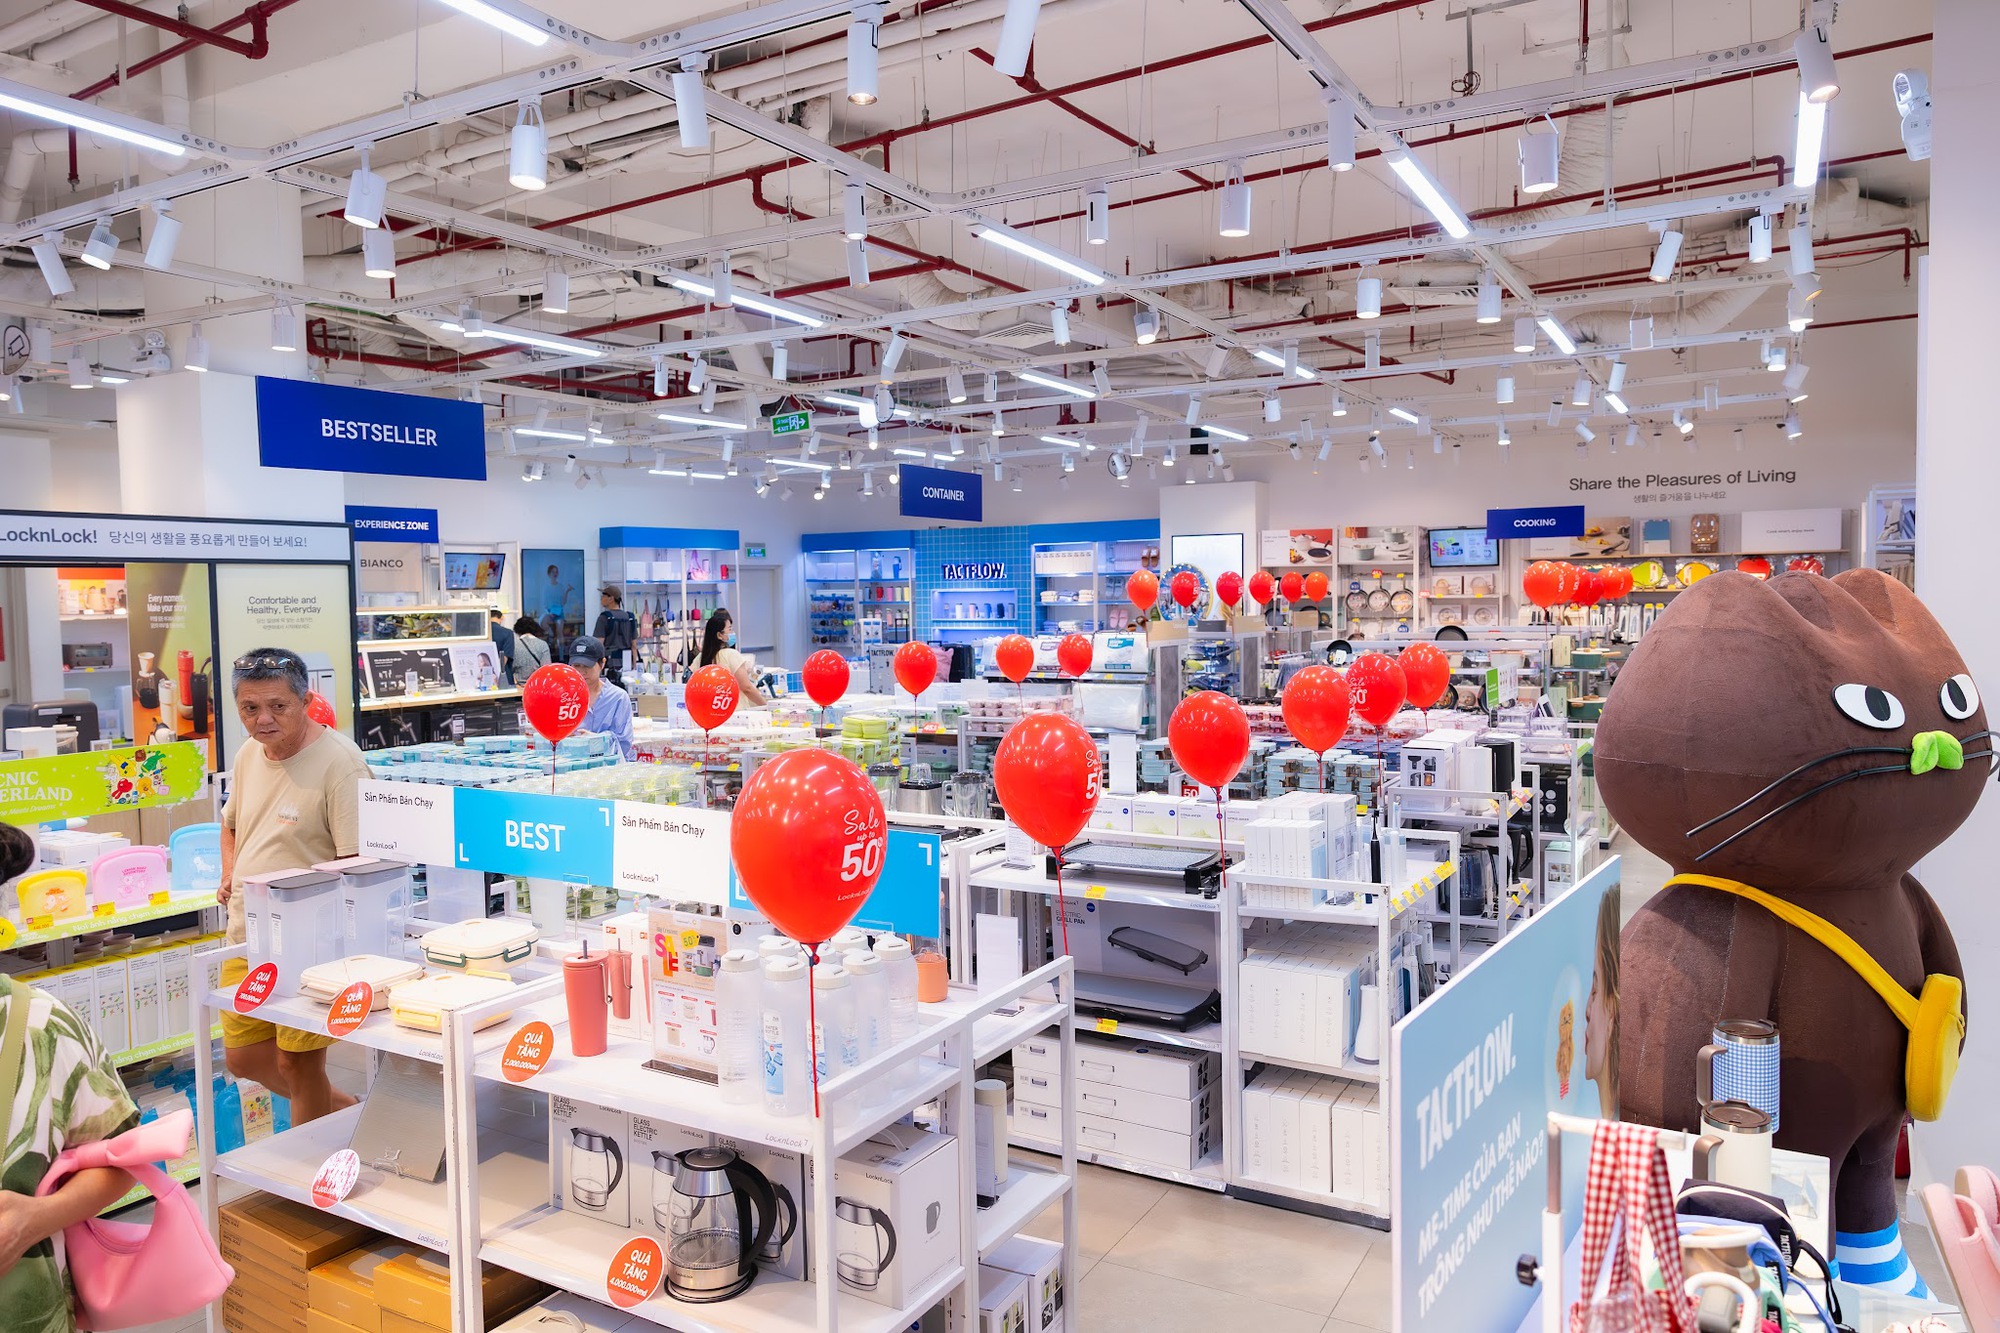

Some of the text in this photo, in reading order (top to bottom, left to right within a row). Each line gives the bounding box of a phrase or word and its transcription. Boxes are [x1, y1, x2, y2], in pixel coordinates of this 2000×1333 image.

[321, 418, 438, 446] BESTSELLER
[1569, 469, 1797, 491] Share the Pleasures of Living
[922, 486, 965, 502] CONTAINER
[355, 519, 430, 531] EXPERIENCE ZONE
[1513, 518, 1557, 528] COOKING
[0, 527, 98, 543] ocknLock!
[109, 531, 308, 548] 당신의 생활을 풍요롭게 만들어 보세요!
[360, 559, 403, 568] BIANCO
[942, 562, 1007, 580] TACTFLOW.
[248, 596, 316, 604] Comfortable and
[147, 604, 161, 612] Make
[162, 604, 173, 613] your
[247, 606, 321, 615] Healthy, Everyday
[560, 692, 580, 703] Sale
[400, 795, 413, 805] Bán
[414, 797, 434, 810] Chạy
[622, 815, 636, 827] Sản
[664, 821, 679, 833] Bán
[682, 823, 705, 838] Chạy
[844, 806, 880, 835] Sale
[505, 820, 566, 852] BEST
[366, 841, 394, 849] LocknLock
[622, 871, 656, 883] LocknLock
[90, 919, 106, 928] ánh
[107, 914, 129, 927] nắng
[128, 911, 150, 921] chạm
[152, 907, 166, 915] vào
[167, 902, 192, 912] những
[248, 981, 267, 994] TẶNG
[340, 1003, 361, 1016] TẶNG
[135, 1048, 156, 1059] chạm
[157, 1044, 172, 1052] vào
[173, 1037, 195, 1048] nhữn
[516, 1045, 541, 1059] TẶNG
[419, 1049, 444, 1061] LocknLoc
[1416, 1013, 1517, 1170] TACTFLOW.
[553, 1095, 570, 1105] GLASS
[553, 1102, 577, 1113] ELECTRIC
[553, 1109, 572, 1119] KETTLE
[633, 1116, 650, 1127] GLASS
[633, 1124, 658, 1136] ELECTRIC
[633, 1130, 653, 1141] KETTLE
[680, 1128, 704, 1139] LocknLock
[719, 1137, 736, 1147] GLASS
[765, 1133, 802, 1147] LocknLock
[769, 1150, 795, 1161] LocknLock
[865, 1172, 893, 1184] LocknLock
[1418, 1111, 1521, 1265] ME-TIME CỦA BẠN
[417, 1232, 445, 1247] LocknLock
[623, 1262, 648, 1281] TẶNG
[1418, 1232, 1465, 1319] TRÔNG
